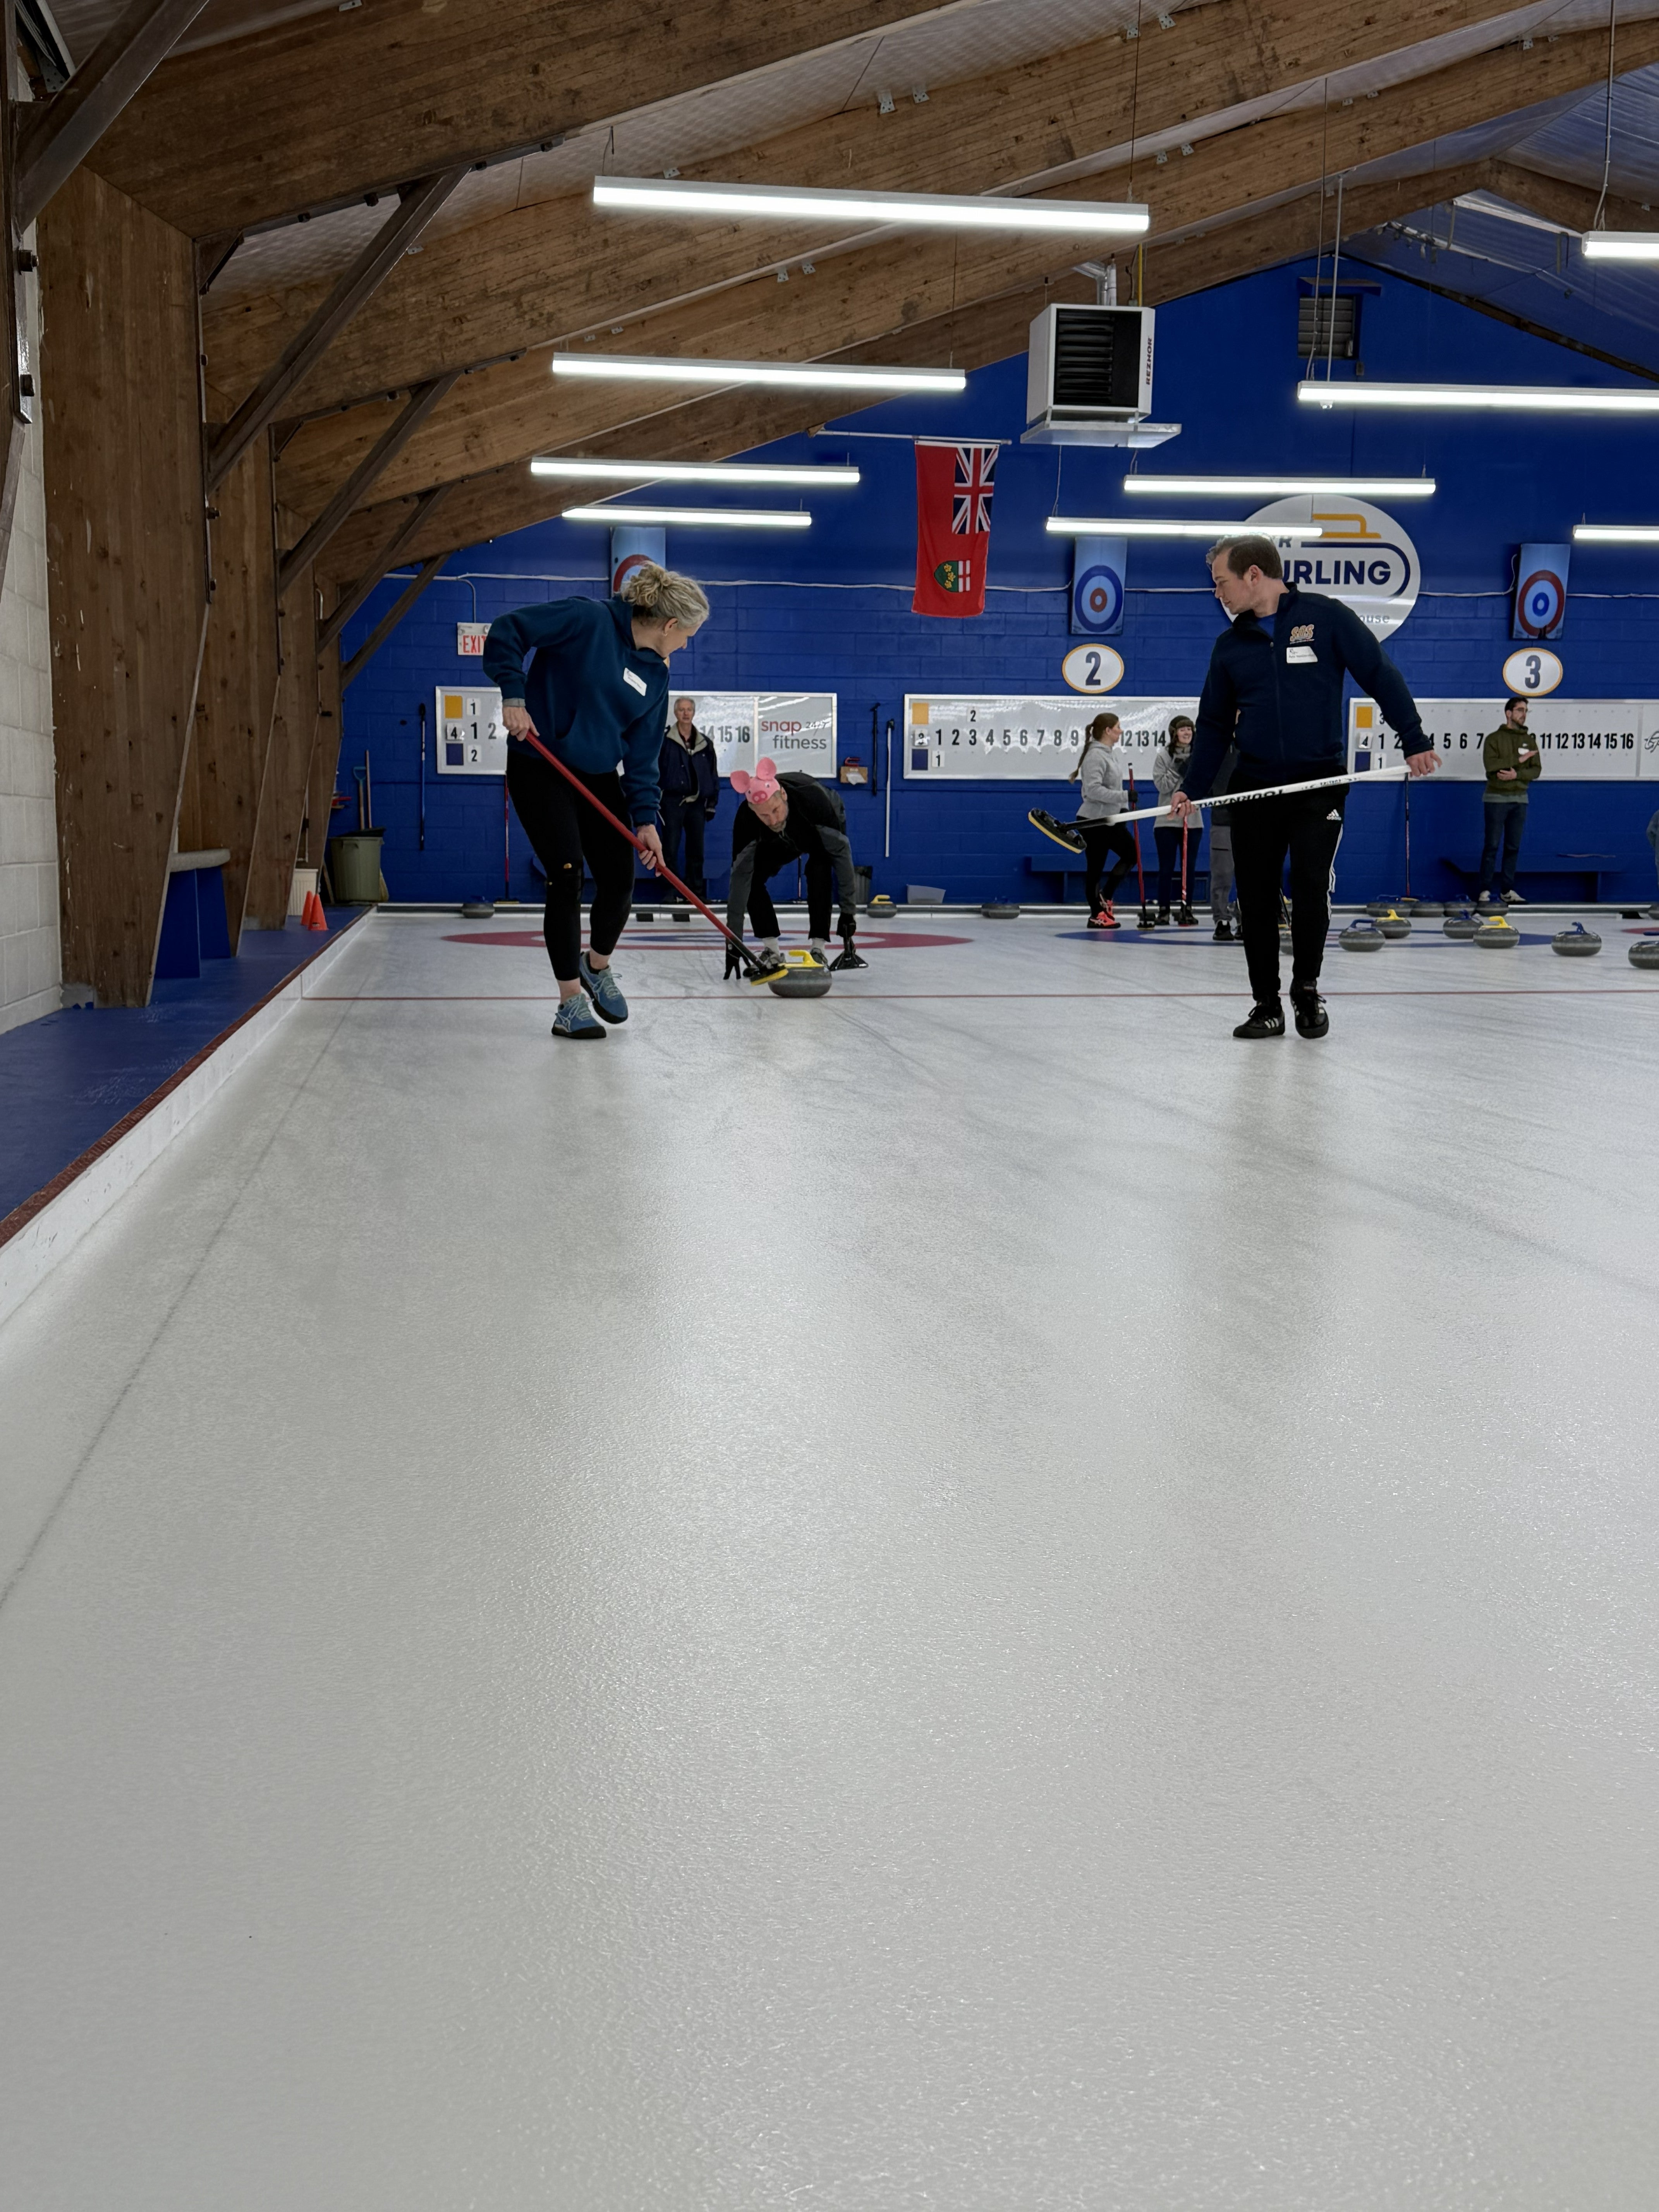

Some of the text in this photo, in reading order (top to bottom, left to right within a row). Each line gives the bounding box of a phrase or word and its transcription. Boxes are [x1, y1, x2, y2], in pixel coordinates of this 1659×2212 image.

[1085, 651, 1101, 685] 2
[1525, 655, 1541, 689] 3
[471, 702, 475, 714] 1
[970, 710, 976, 721] 2
[451, 727, 457, 739] 4
[471, 722, 477, 739] 1
[488, 723, 496, 739] 2
[718, 726, 732, 742] 15
[735, 726, 750, 742] 16
[761, 721, 802, 735] snap
[773, 735, 827, 749] fitness
[936, 729, 1166, 747] 1 2 3 4 5 6 7 8 9 12 13 14
[1379, 733, 1384, 749] 1
[1395, 733, 1402, 749] 2
[1444, 733, 1451, 749] 5
[1460, 733, 1467, 749] 6
[1477, 733, 1484, 749] 7
[1540, 733, 1551, 749] 11
[1556, 733, 1568, 749] 12
[1572, 733, 1585, 749] 13
[1588, 733, 1601, 749] 14
[1604, 733, 1617, 749] 15
[1621, 733, 1634, 749] 16
[471, 749, 477, 762] 2
[936, 755, 940, 767] 1
[1378, 757, 1382, 769] 1
